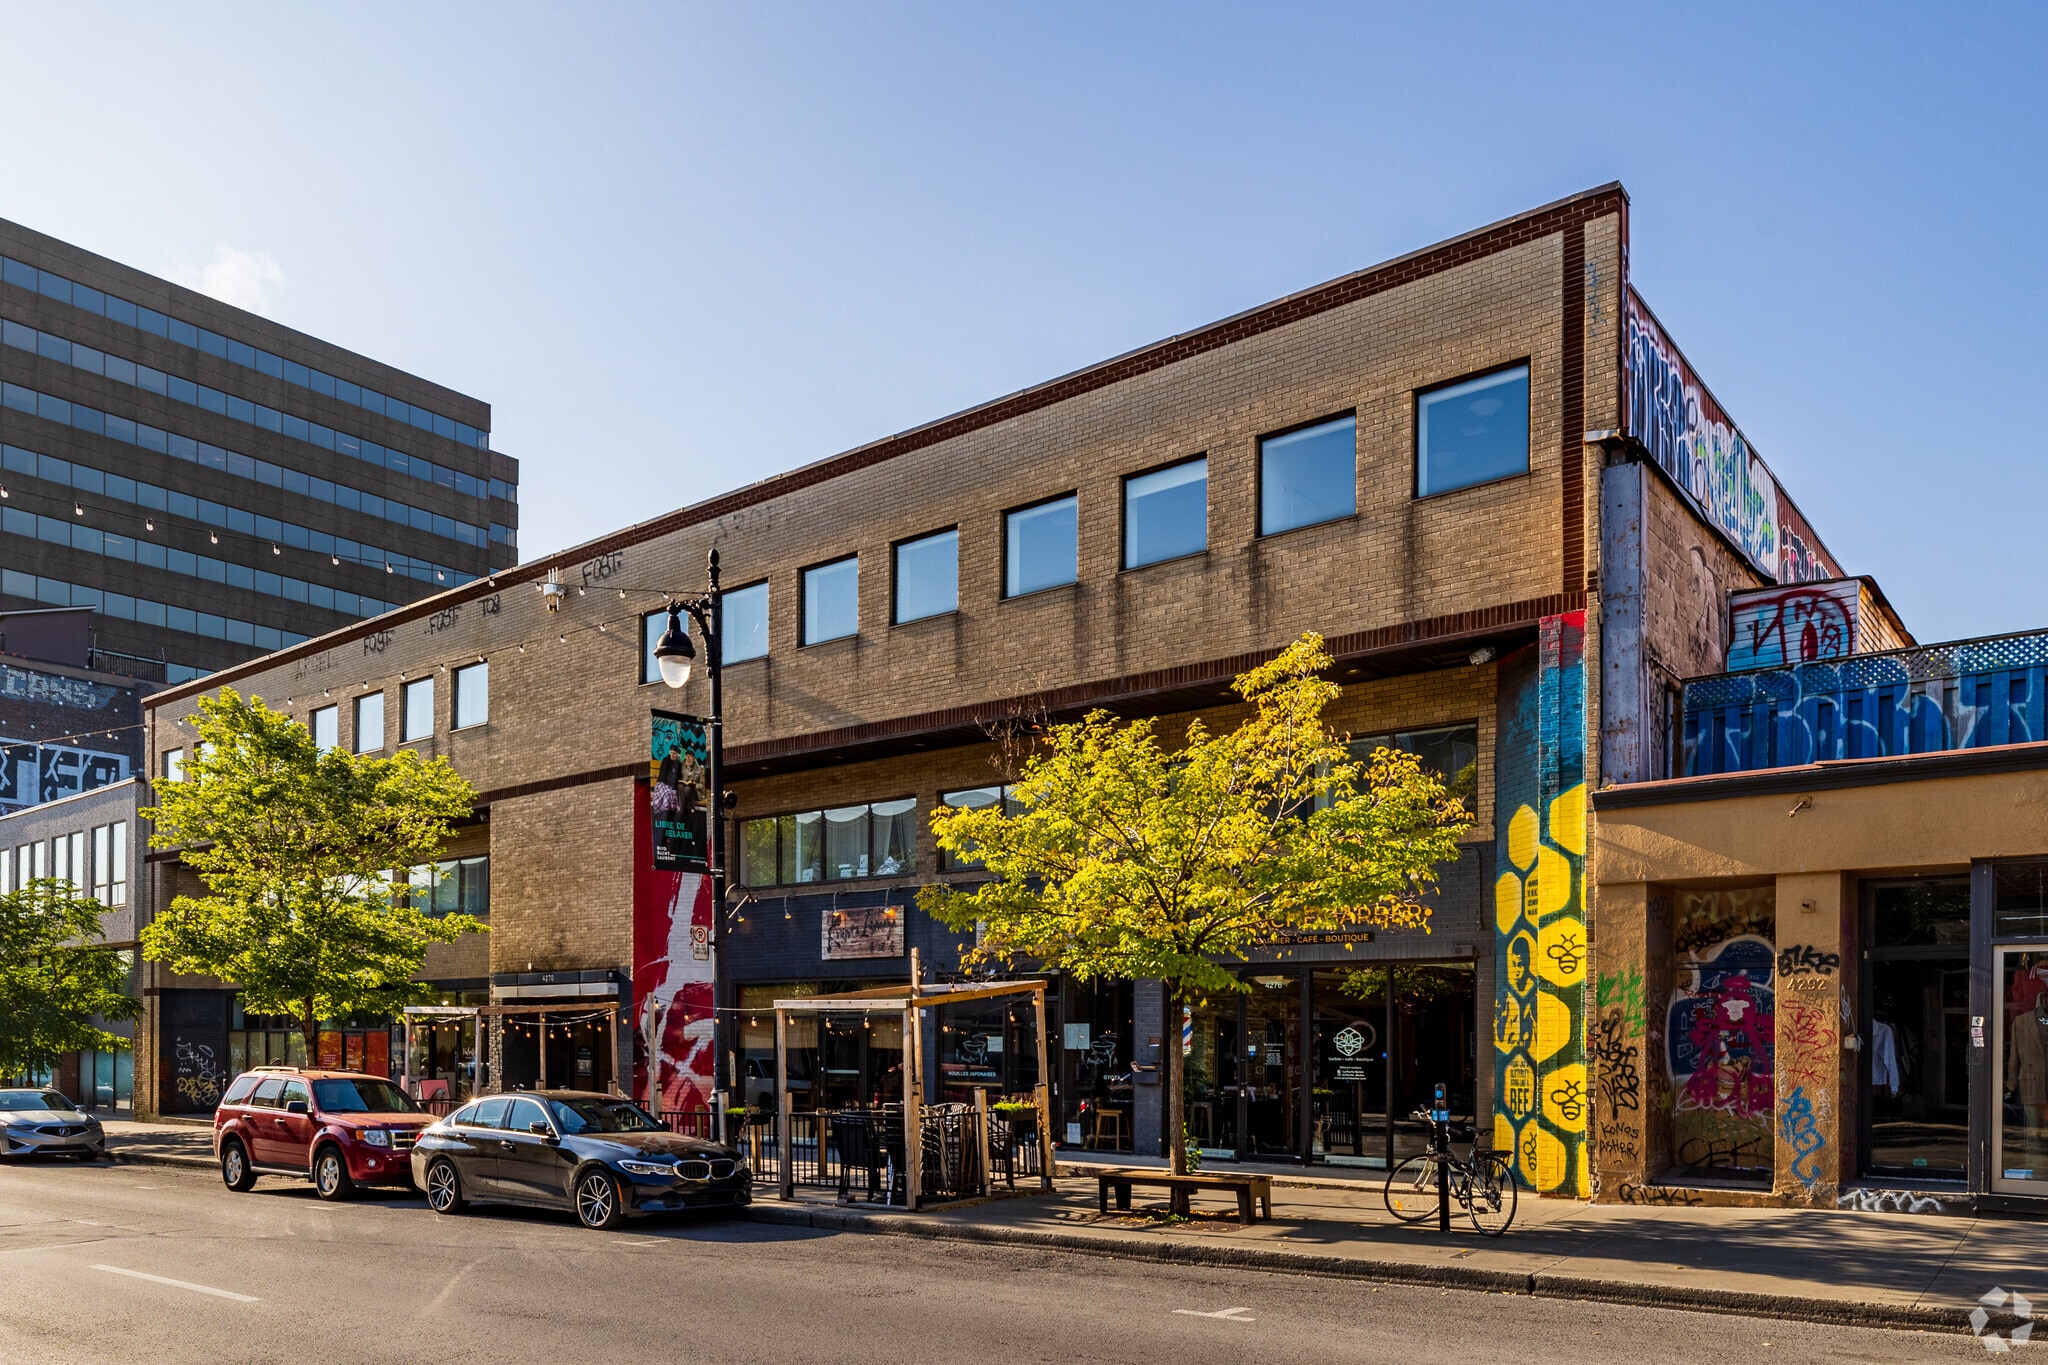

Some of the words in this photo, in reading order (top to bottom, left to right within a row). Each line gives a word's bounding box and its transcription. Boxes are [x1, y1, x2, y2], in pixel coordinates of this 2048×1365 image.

[655, 820, 674, 829] LIBRE
[676, 822, 685, 830] DE
[665, 829, 693, 839] RELAXER
[1297, 934, 1318, 943] CAFÉ
[1325, 933, 1369, 943] BOUTIQUE
[541, 974, 555, 982] 4270
[1264, 981, 1283, 989] 4276
[1787, 978, 1827, 991] 4292
[1510, 1088, 1529, 1115] BEE
